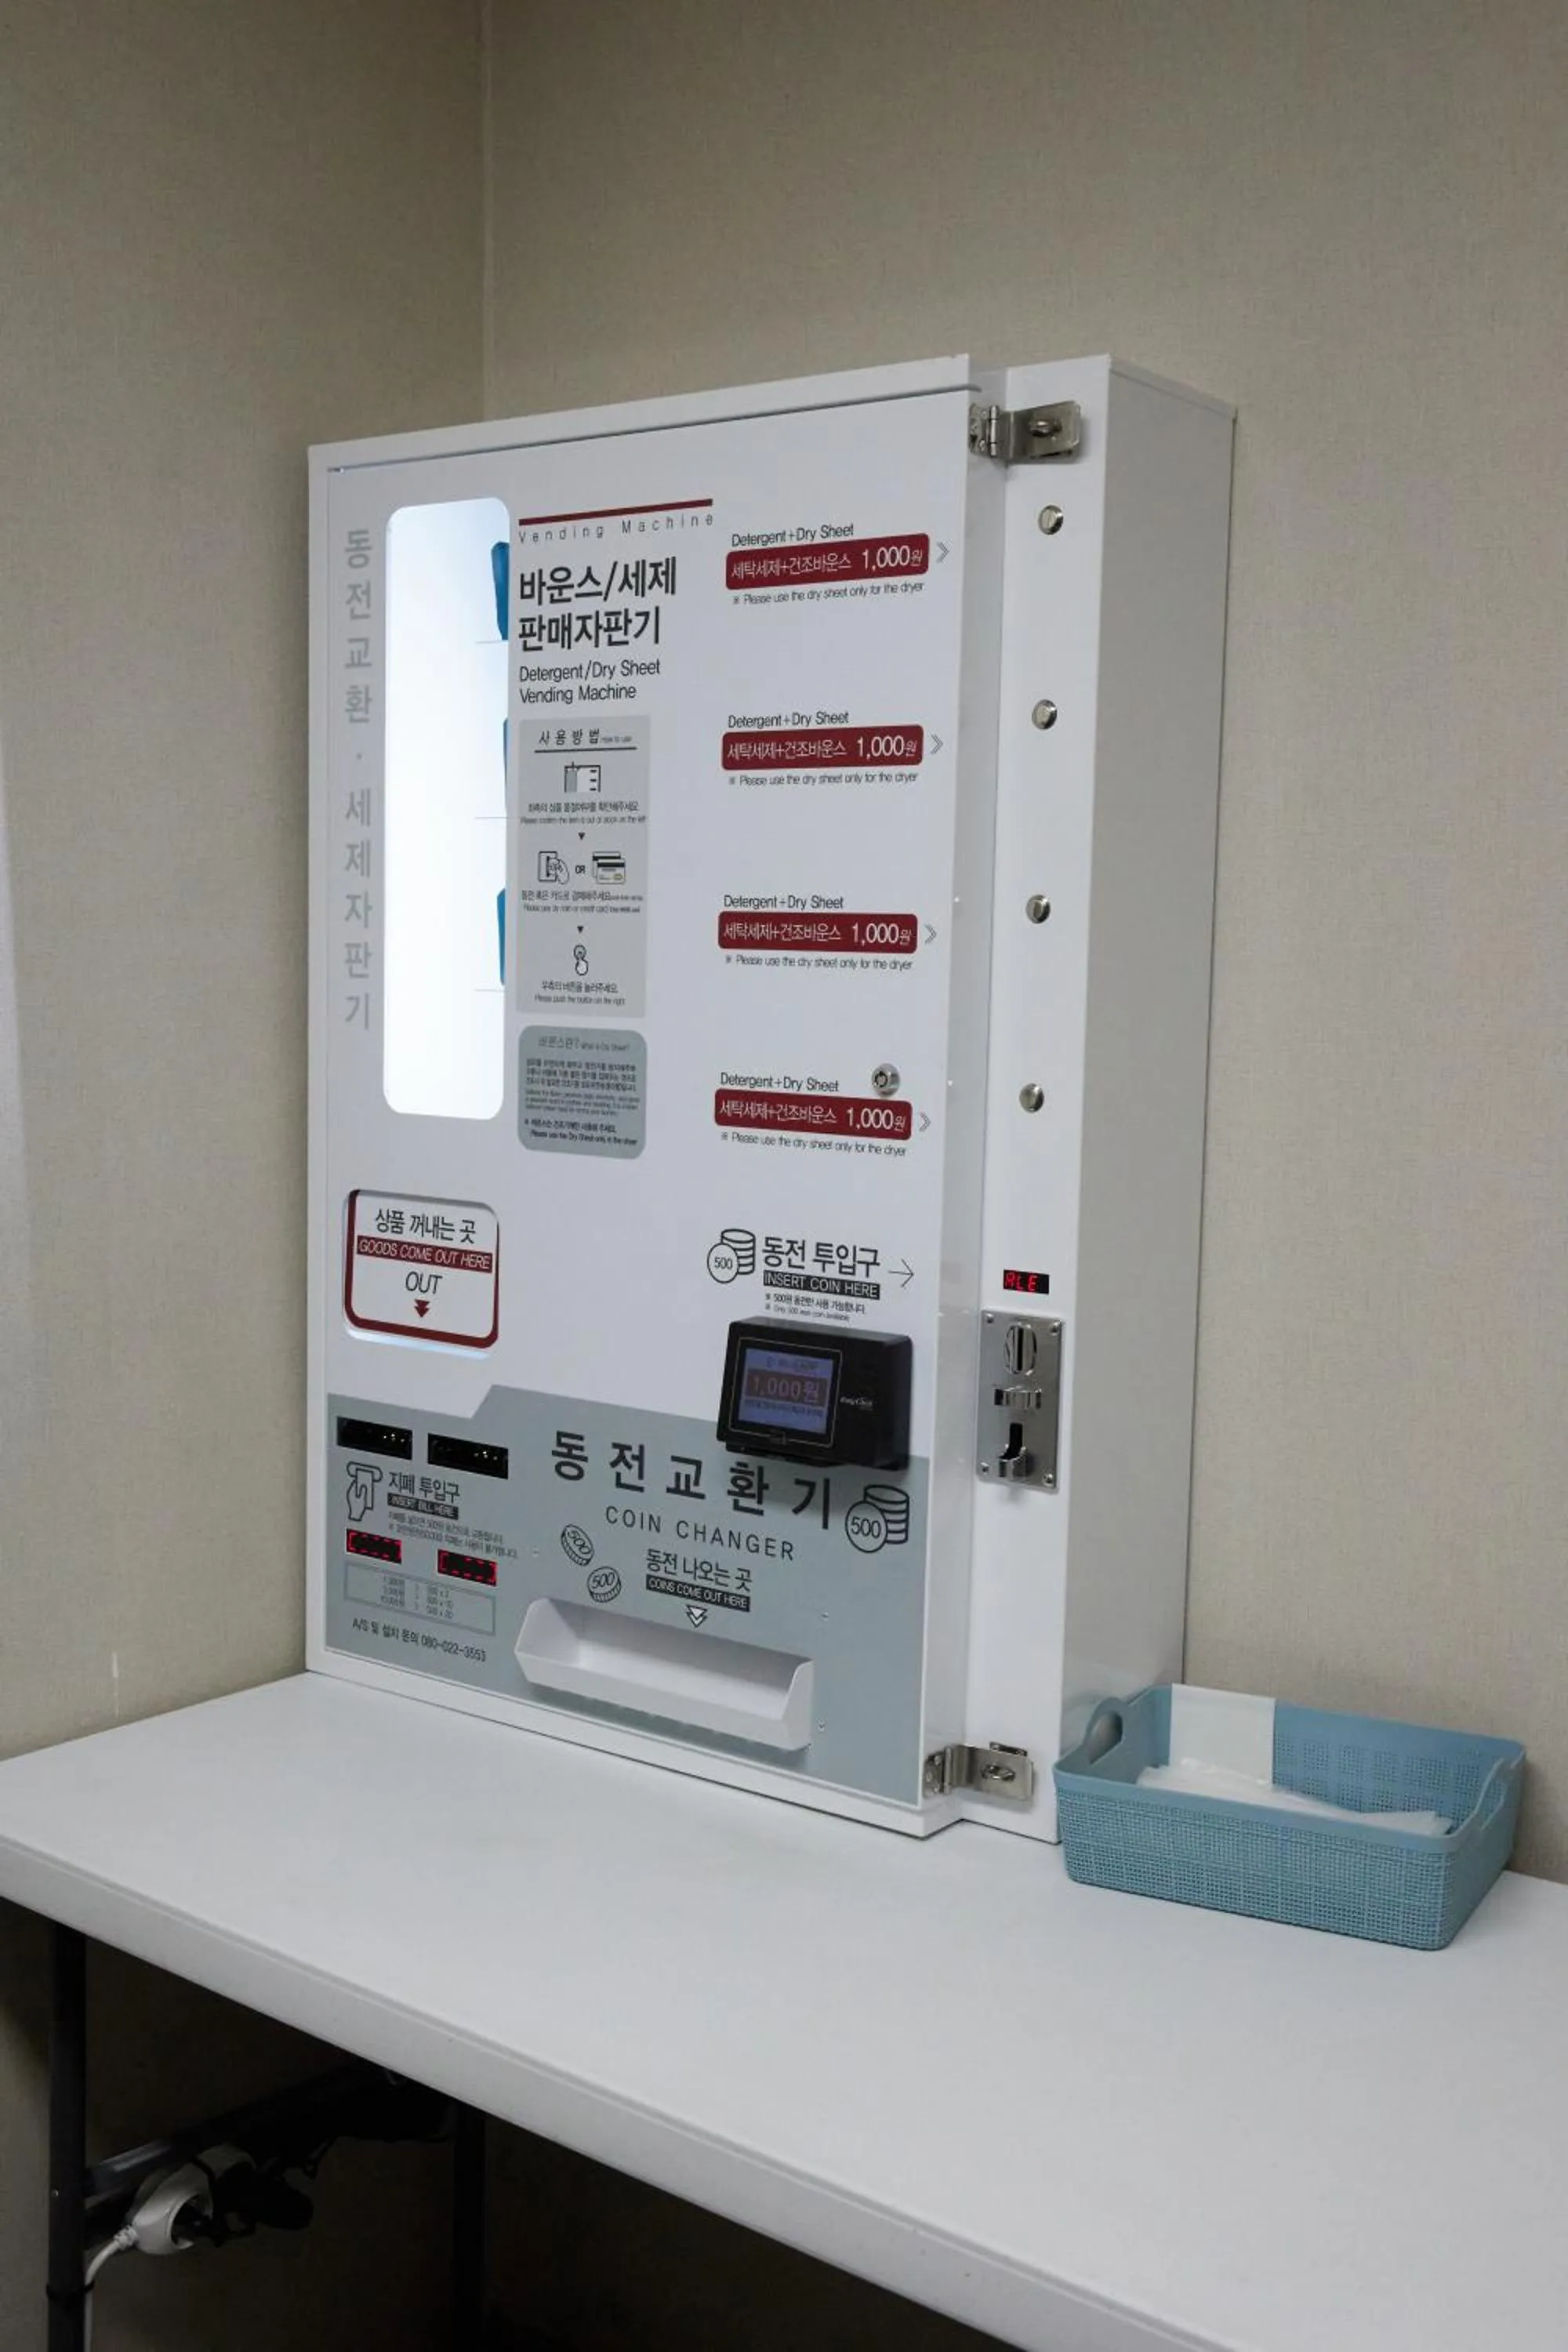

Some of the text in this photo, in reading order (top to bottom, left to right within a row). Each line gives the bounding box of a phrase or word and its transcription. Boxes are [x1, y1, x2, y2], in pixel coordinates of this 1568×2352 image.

[518, 514, 713, 543] Vending Machine
[820, 524, 854, 538] Sheet
[520, 556, 677, 606] 바운스/세제
[884, 583, 898, 593] the
[518, 606, 660, 652] 판매자판기
[519, 659, 661, 683] Detergent/Dry Sheet
[520, 684, 637, 705] Vending Machine
[816, 711, 849, 725] Sheet
[879, 772, 893, 782] the
[575, 866, 585, 874] OR
[811, 895, 844, 909] Sheet
[873, 959, 887, 969] the
[807, 1076, 839, 1092] Sheet
[868, 1144, 882, 1154] the
[376, 1208, 477, 1244] 상품 꺼내는 곳
[359, 1239, 490, 1269] GOODS COME OUT HERE
[714, 1256, 733, 1270] 500
[762, 1236, 880, 1278] 동전 투입구
[405, 1271, 442, 1294] OUT
[764, 1272, 878, 1298] INSERT COIN HERE
[389, 1472, 460, 1503] 지폐 투입구
[605, 1505, 794, 1561] COIN CHANGER
[850, 1517, 882, 1539] 500
[567, 1530, 592, 1555] 500
[592, 1571, 615, 1588] 500
[646, 1548, 753, 1592] 동전 나오는 곳
[649, 1577, 747, 1608] COINS COME OUT HERE
